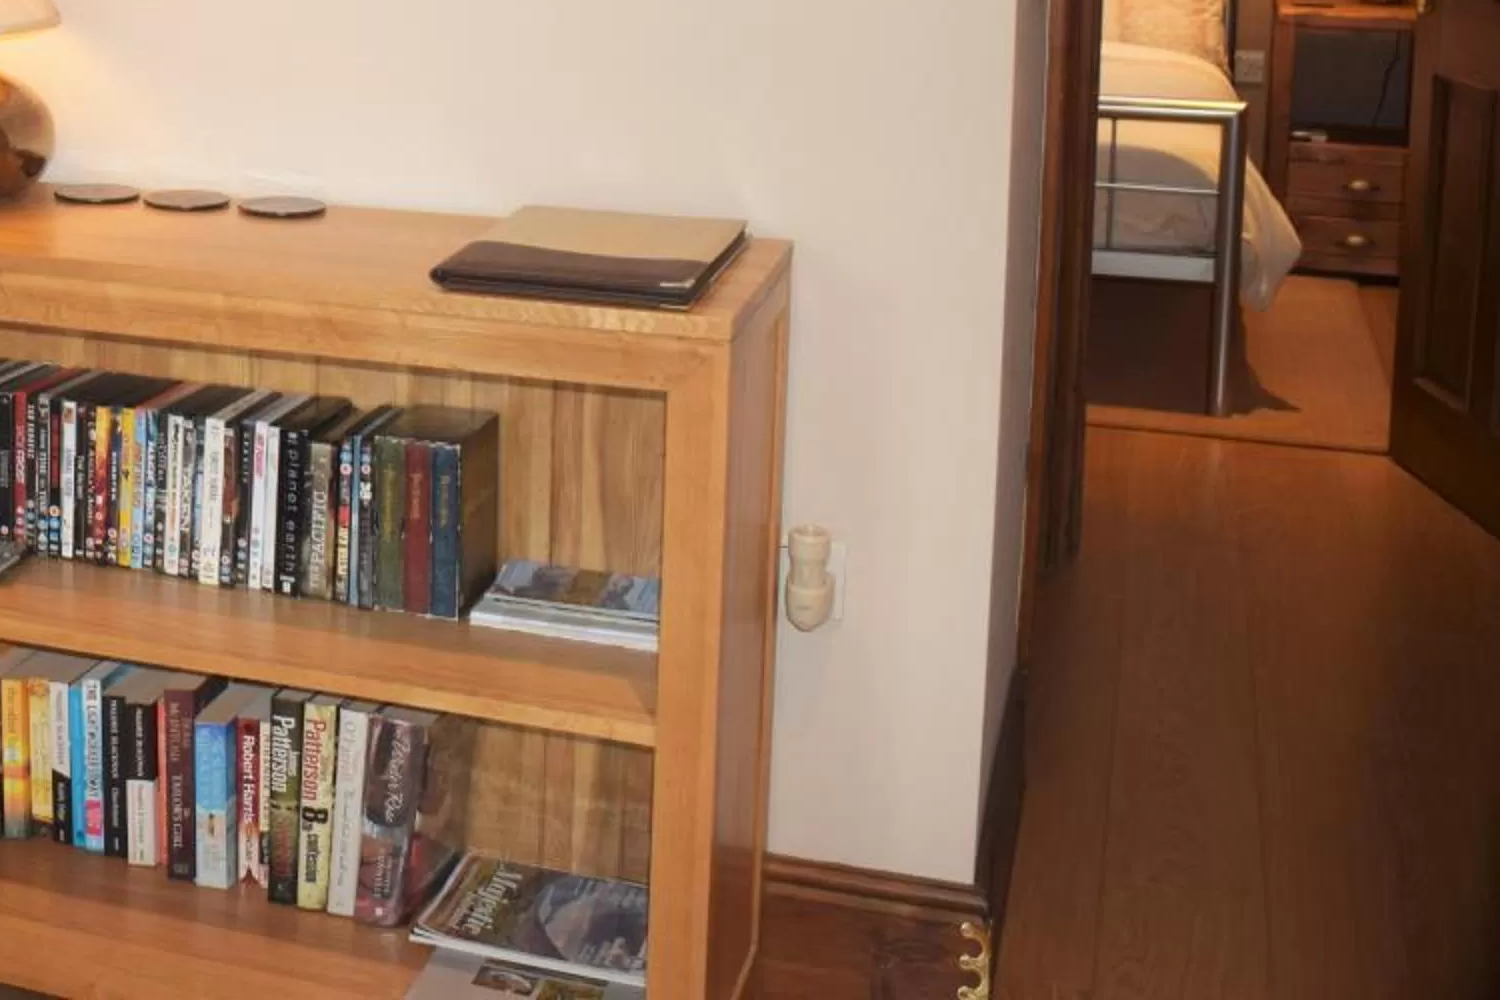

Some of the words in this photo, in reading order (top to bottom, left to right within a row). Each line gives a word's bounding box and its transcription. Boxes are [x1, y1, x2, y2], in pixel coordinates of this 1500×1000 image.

[286, 448, 301, 512] planet
[283, 519, 297, 573] earth
[243, 735, 256, 781] Robert
[271, 714, 296, 793] Patterson
[288, 749, 299, 777] James
[302, 718, 328, 801] Patterson
[243, 783, 256, 825] Harris
